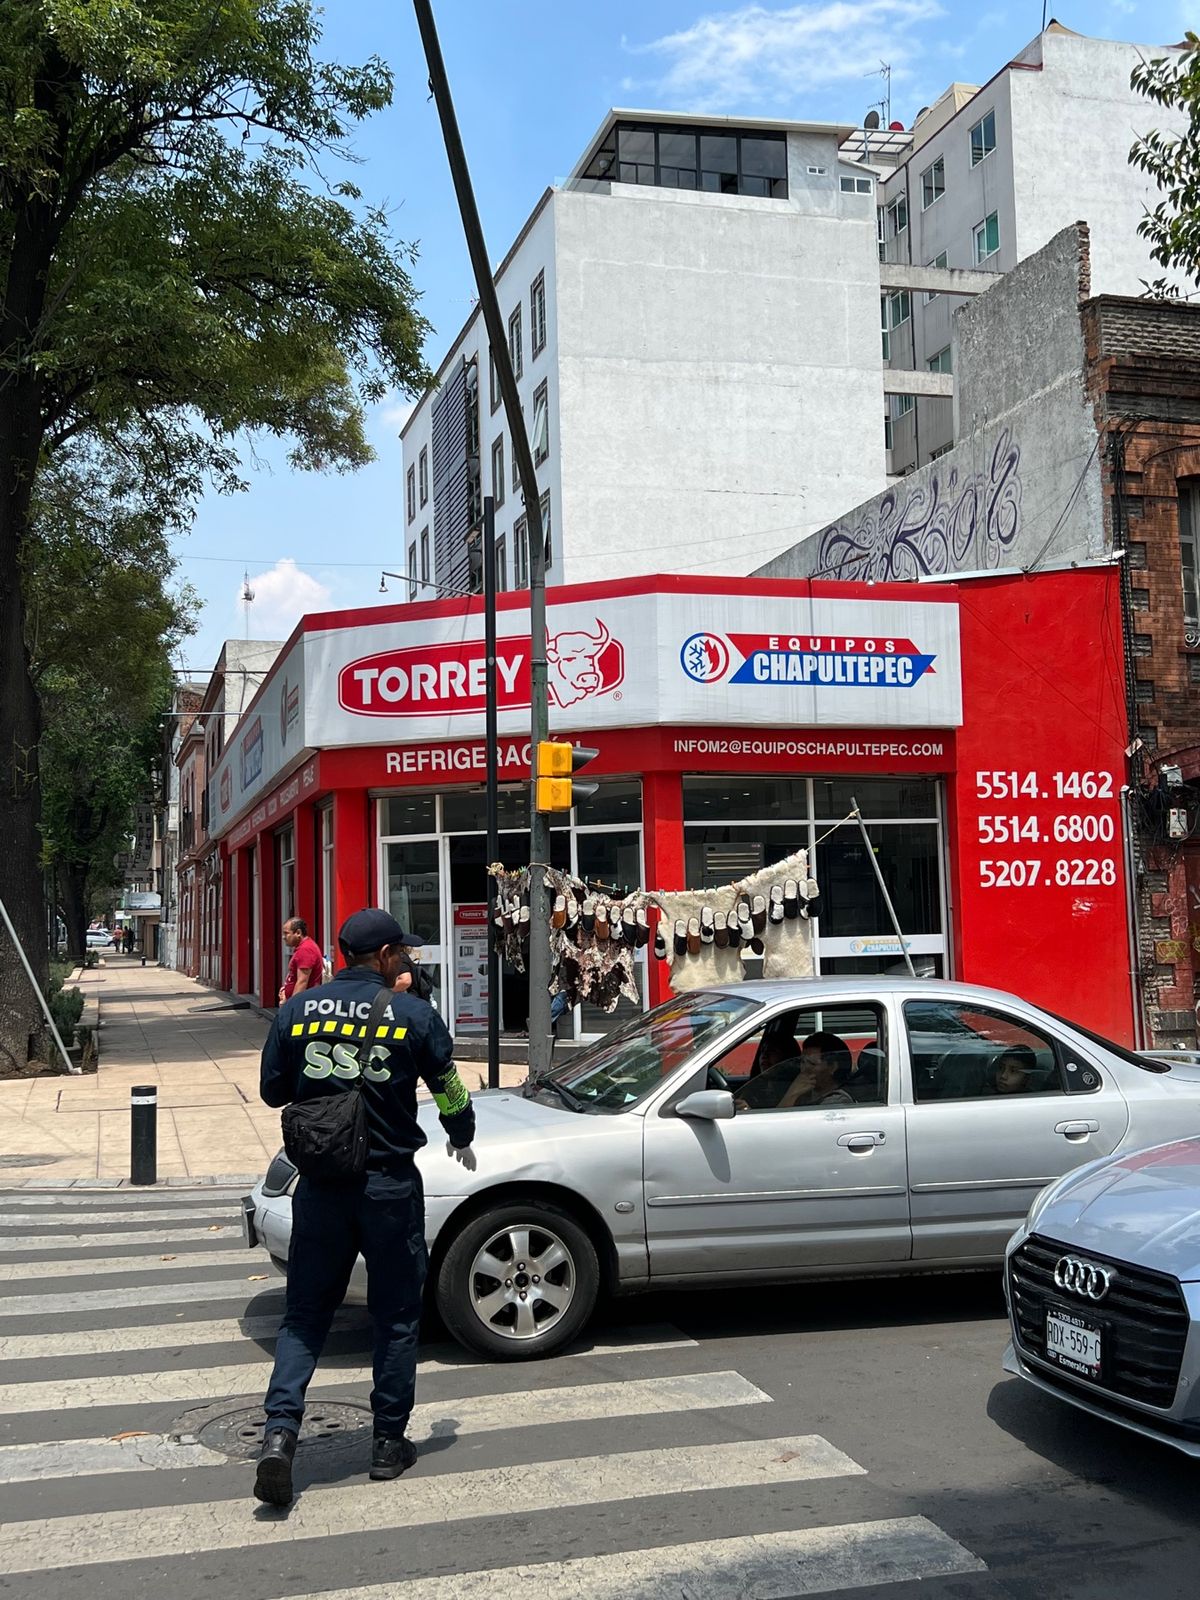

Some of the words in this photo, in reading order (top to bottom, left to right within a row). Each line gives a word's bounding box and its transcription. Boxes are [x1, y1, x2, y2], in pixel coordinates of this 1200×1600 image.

[769, 637, 895, 653] EQUIPOS
[353, 655, 524, 705] TORREY
[753, 653, 913, 684] CHAPULTEPEC
[673, 739, 944, 756] INFOM2@EQUIPOSCHAPULTEPEC.COM
[976, 771, 1114, 799] 5514.1462
[978, 815, 1115, 844] 5514.6800
[979, 859, 1117, 888] 5207.8228
[303, 998, 395, 1021] POLICA
[303, 1041, 392, 1082] SSC
